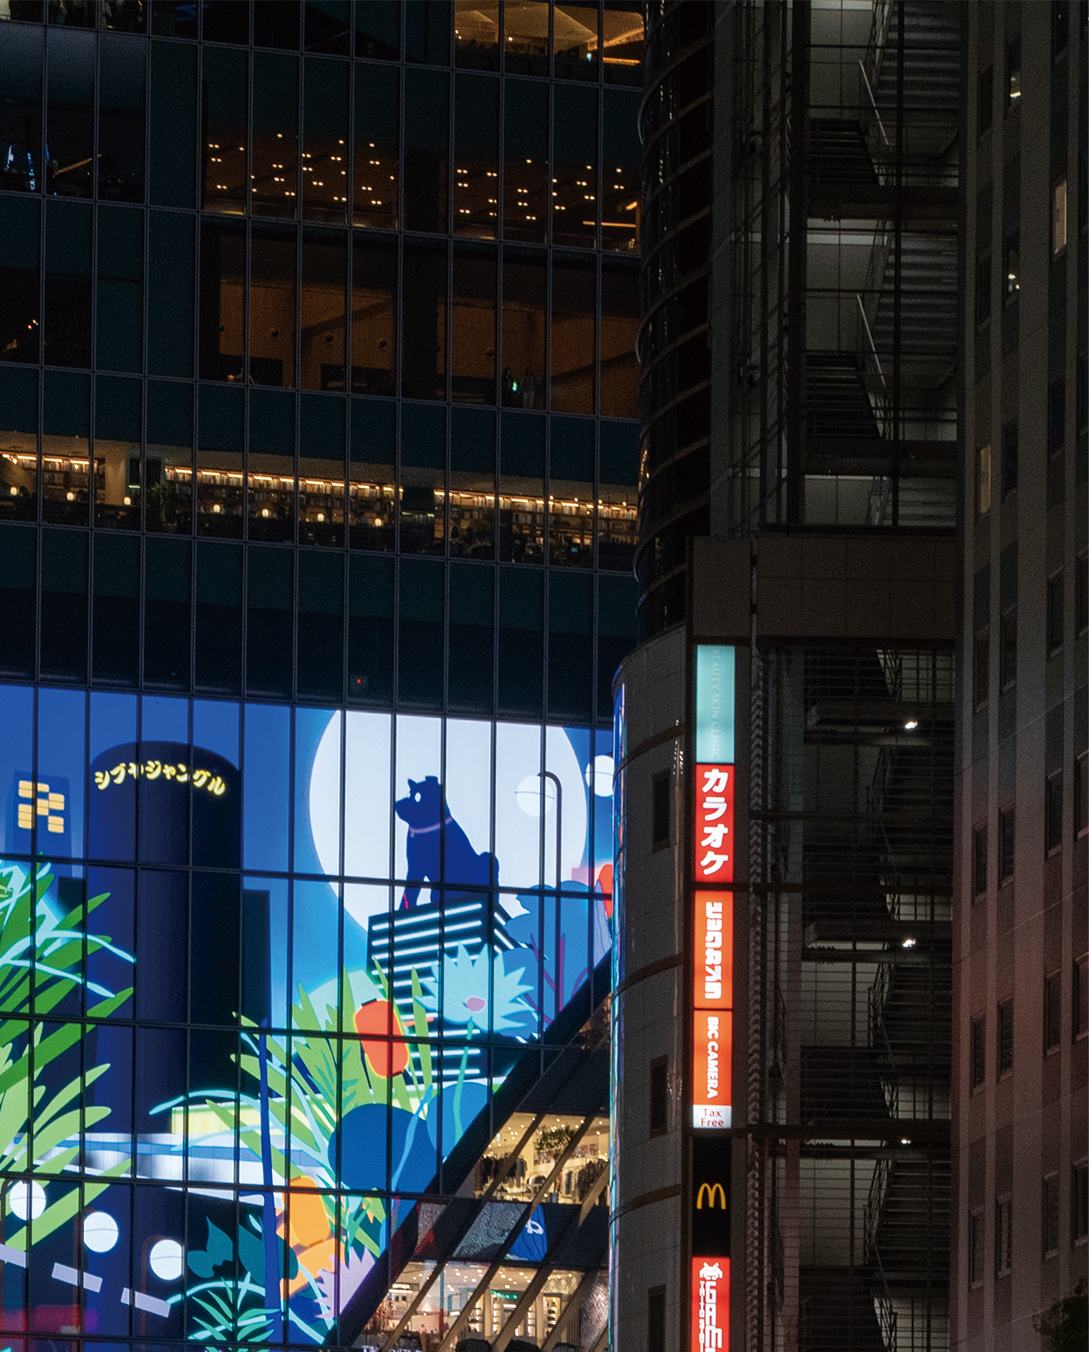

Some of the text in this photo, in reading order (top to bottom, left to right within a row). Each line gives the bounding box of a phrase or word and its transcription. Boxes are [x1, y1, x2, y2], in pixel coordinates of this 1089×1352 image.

[711, 649, 720, 760] BEAUTY SKIN CLINIC
[700, 769, 729, 875] カラオケ
[705, 902, 722, 999] ビックカメラ
[707, 1017, 719, 1098] BIC CAMERA
[701, 1118, 724, 1128] Free
[703, 1108, 722, 1117] Tax
